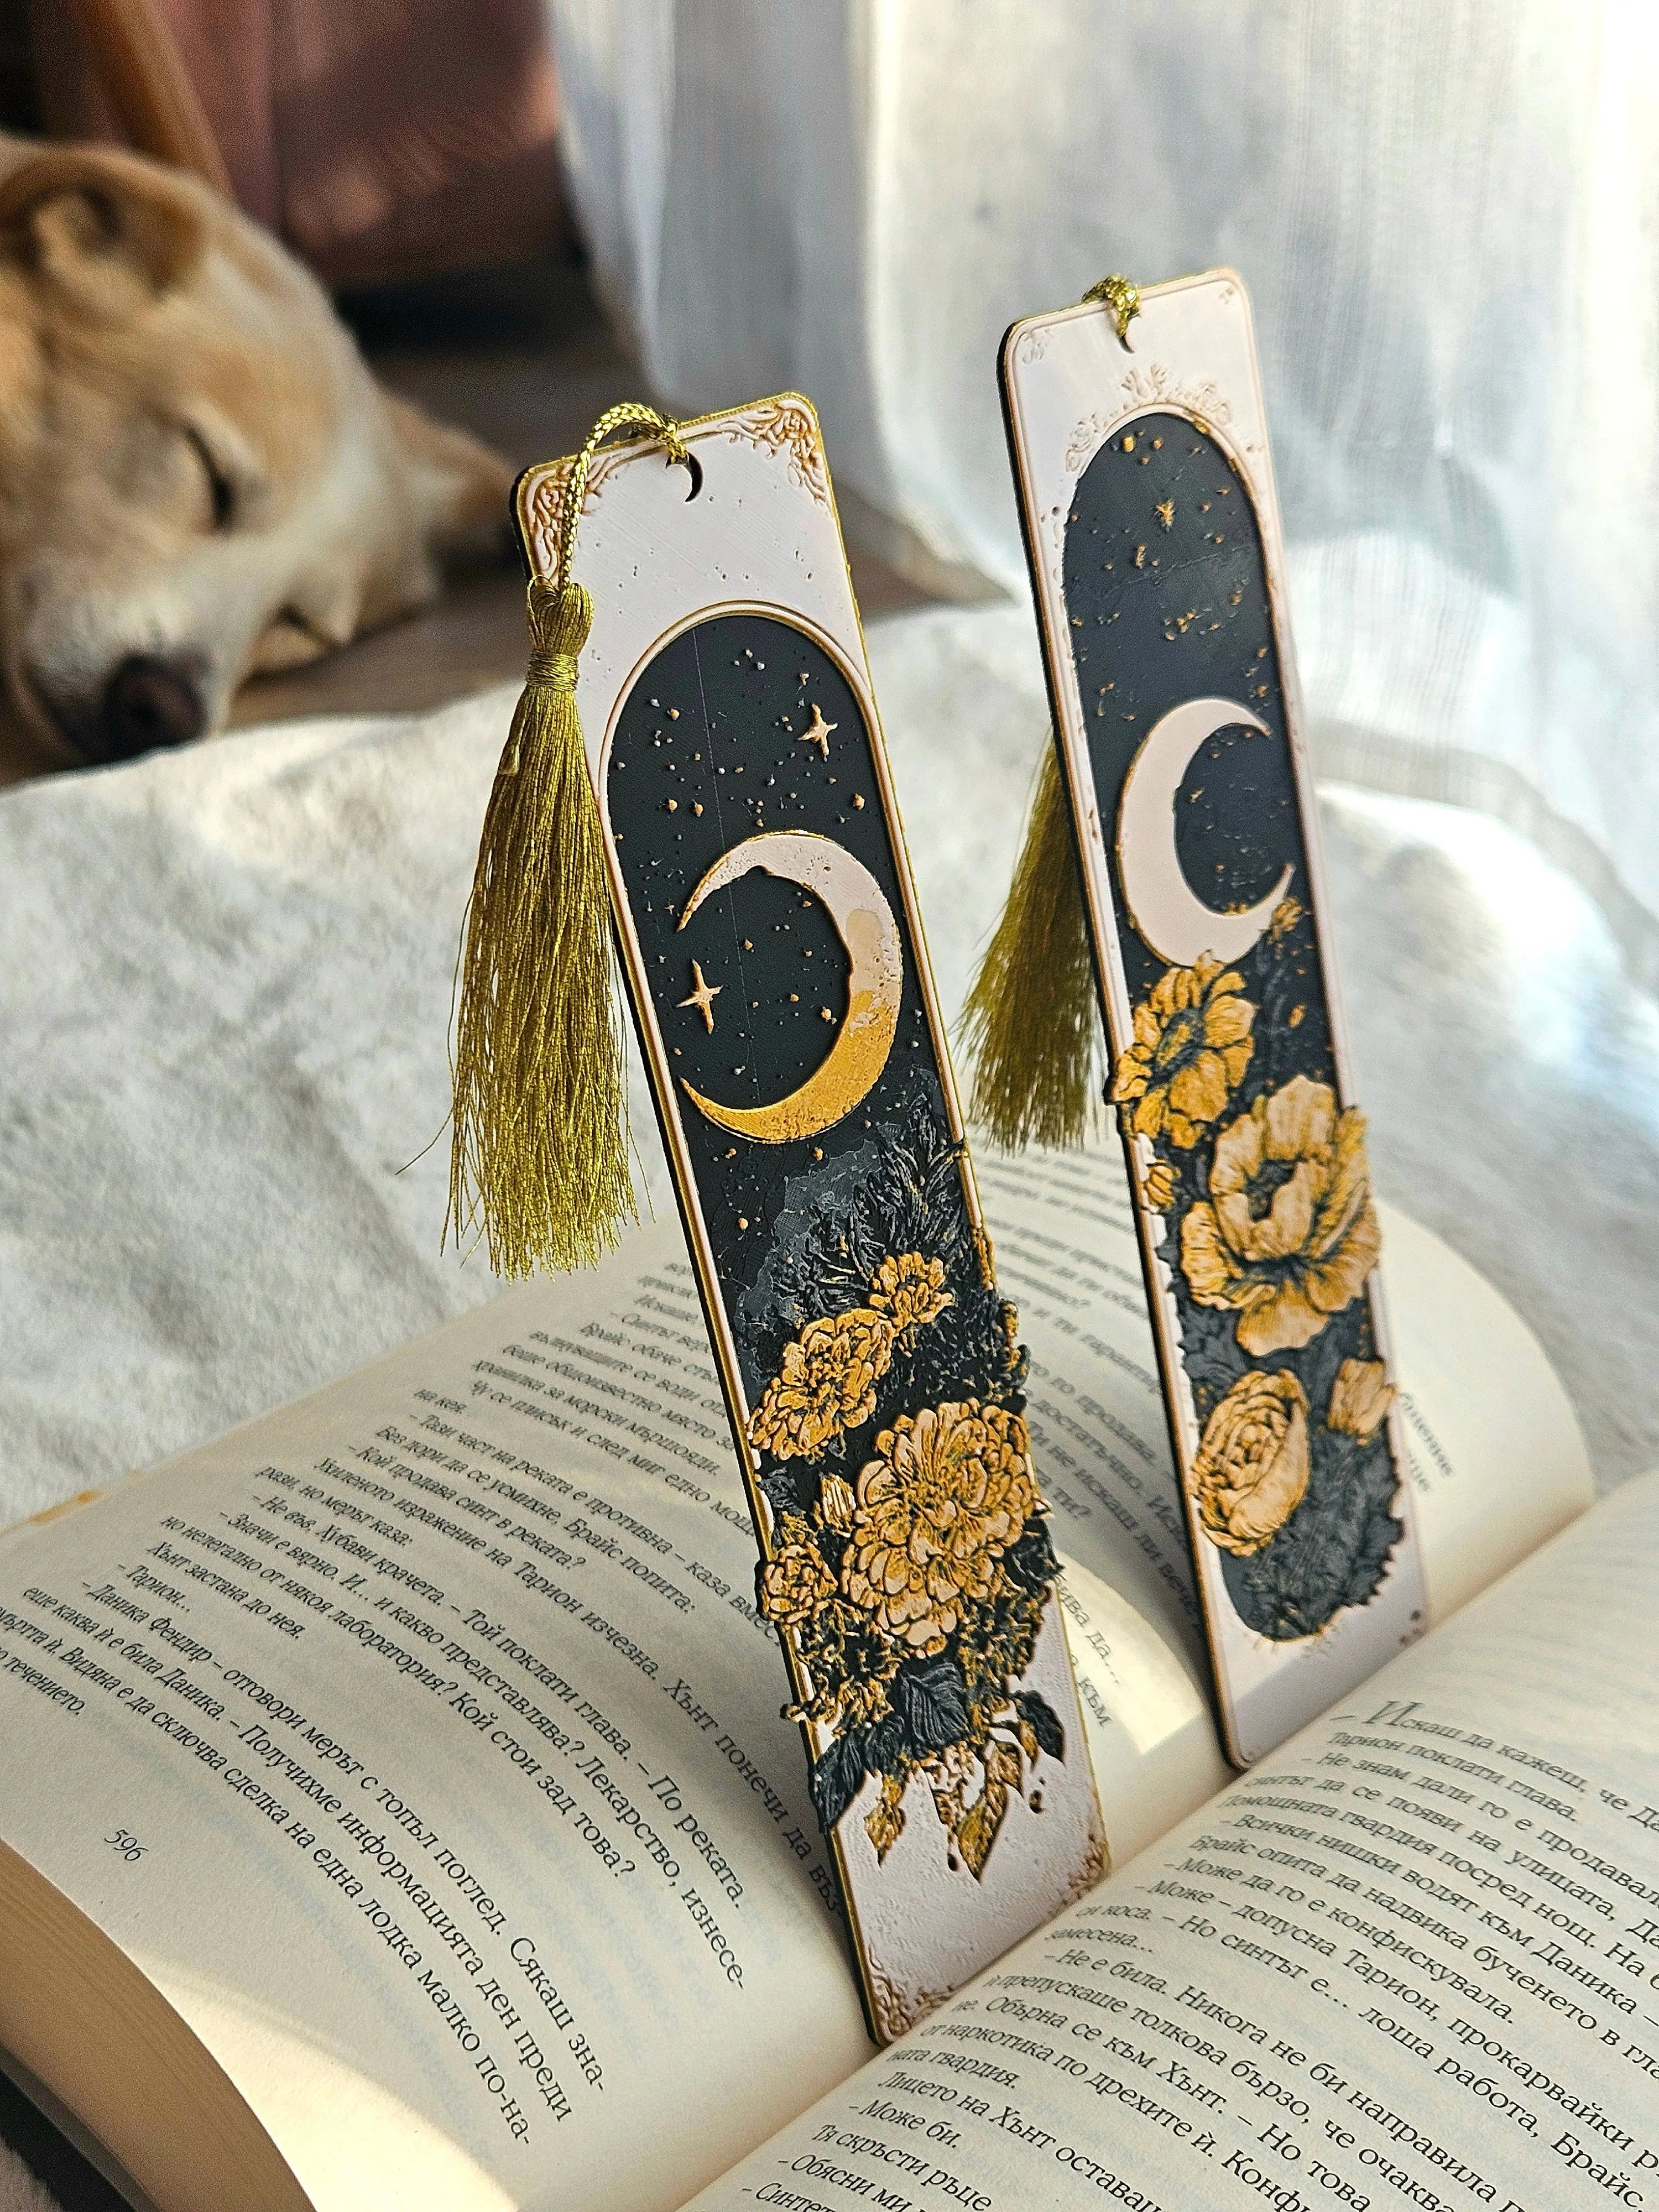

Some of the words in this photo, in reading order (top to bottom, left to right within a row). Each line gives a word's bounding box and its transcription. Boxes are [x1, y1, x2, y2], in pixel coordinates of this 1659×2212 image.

[563, 1395, 628, 1426] морски
[661, 1410, 716, 1438] място
[299, 1485, 325, 1499] но
[321, 1496, 374, 1524] мерът
[419, 1415, 458, 1438] Тази
[572, 1491, 588, 1500] е
[585, 1498, 672, 1554] противна
[685, 1562, 731, 1598] каза
[587, 1434, 630, 1459] след
[627, 1454, 666, 1474] миг
[665, 1474, 710, 1501] едно
[441, 1459, 468, 1474] да
[467, 1470, 491, 1483] се
[483, 1479, 561, 1525] усмихне,
[564, 1519, 623, 1558] Брайс
[456, 1497, 500, 1521] синт
[495, 1518, 512, 1528] в
[504, 1526, 586, 1569] реката?
[147, 1541, 191, 1568] Хънт
[185, 1564, 249, 1603] застана
[241, 1599, 272, 1614] до
[267, 1613, 305, 1639] нея.
[3, 1657, 85, 1715] течението.
[59, 1647, 121, 1691] Видяна
[117, 1688, 134, 1698] е
[485, 1548, 512, 1567] на
[514, 1562, 583, 1614] Тарион
[580, 1611, 659, 1681] изчезна.
[663, 1678, 718, 1731] Хънт
[714, 1734, 789, 1824] понечи
[1085, 1630, 1119, 1684] да...
[124, 1696, 155, 1715] да
[160, 1516, 186, 1530] но
[260, 1569, 285, 1583] от
[279, 1579, 334, 1613] някоя
[328, 1610, 458, 1695] лаборатория?
[449, 1692, 498, 1731] Кой
[491, 1731, 542, 1776] стои
[537, 1776, 577, 1815] зад
[574, 1812, 635, 1877] това?
[260, 1496, 288, 1514] Не
[463, 1609, 505, 1641] Той
[496, 1638, 579, 1703] поклати
[574, 1702, 630, 1761] глава.
[648, 1775, 682, 1811] По
[674, 1813, 743, 1908] реката.
[1078, 1676, 1113, 1729] към
[152, 1712, 227, 1770] сключва
[275, 1541, 290, 1550] е
[373, 1597, 394, 1610] и
[388, 1606, 444, 1644] какво
[440, 1642, 585, 1752] представлява?
[575, 1756, 680, 1886] Лекарство,
[681, 1888, 743, 1989] изнесе-
[1361, 1701, 1464, 1739] Искаш
[1460, 1734, 1494, 1749] да
[1600, 1790, 1629, 1810] че
[224, 1768, 289, 1824] сделка
[1316, 1752, 1351, 1766] Не
[1352, 1760, 1411, 1780] знам
[1411, 1776, 1476, 1804] дали
[1478, 1801, 1509, 1818] го
[1515, 1819, 1532, 1830] е
[1405, 1745, 1506, 1784] поклати
[1505, 1781, 1576, 1822] глава.
[52, 1604, 100, 1634] каква
[108, 1638, 124, 1648] е
[121, 1644, 164, 1674] била
[154, 1670, 225, 1721] Даника.
[238, 1724, 341, 1813] Получихме
[337, 1812, 483, 1976] информацията
[476, 1978, 521, 2030] ден
[514, 2031, 572, 2121] преди
[86, 1585, 149, 1624] Даника
[149, 1618, 212, 1662] Фендир
[223, 1670, 307, 1730] отговори
[301, 1726, 364, 1775] мерът
[361, 1777, 378, 1790] с
[377, 1788, 439, 1849] топъл
[434, 1849, 506, 1935] поглед.
[510, 1938, 574, 2031] Сякаш
[568, 2034, 603, 2090] зна-
[104, 1829, 149, 1861] 596
[285, 1822, 315, 1849] на
[314, 1849, 363, 1898] една
[1313, 1780, 1347, 1791] да
[1352, 1787, 1381, 1800] се
[1386, 1797, 1464, 1832] появи
[1467, 1830, 1501, 1852] на
[1504, 1850, 1614, 1921] улицата,
[1233, 1814, 1317, 1840] Всички
[1315, 1835, 1402, 1875] нишки
[1401, 1870, 1479, 1912] водят
[1478, 1911, 1535, 1947] към
[1530, 1942, 1650, 2020] Даника
[1338, 1812, 1438, 1855] гвардия
[1437, 1851, 1533, 1908] посред
[1532, 1903, 1596, 1948] нощ.
[1604, 1942, 1645, 1977] На
[358, 1899, 421, 1969] лодка
[1176, 1858, 1243, 1881] Може
[1240, 1875, 1275, 1891] да
[1275, 1886, 1305, 1902] го
[1308, 1900, 1327, 1911] е
[1327, 1908, 1512, 2023] конфискувала.
[1188, 1835, 1258, 1854] Брайс
[1257, 1849, 1328, 1878] опита
[1325, 1873, 1361, 1893] да
[1363, 1888, 1469, 1950] надвика
[1474, 1946, 1597, 2029] бученето
[1599, 2029, 1620, 2046] в
[418, 1969, 479, 2051] малко
[1147, 1880, 1215, 1903] Може
[1232, 1905, 1337, 1957] допусна
[1343, 1949, 1439, 2021] Тарион,
[1448, 2018, 1634, 2151] прокарвайки
[1178, 1915, 1217, 1937] Но
[1221, 1935, 1308, 1979] синтът
[1311, 1979, 1347, 2007] е...
[1358, 2008, 1434, 2059] лоша
[1434, 2058, 1538, 2137] работа,
[929, 2052, 1020, 2089] гвардия.
[942, 2025, 1054, 2062] наркотика
[1052, 2055, 1088, 2076] по
[1084, 2072, 1192, 2137] дрехите
[986, 1997, 1068, 2028] Обърна
[1072, 2023, 1102, 2041] се
[1103, 2037, 1157, 2069] към
[1156, 2061, 1227, 2114] Хънт.
[1257, 2125, 1301, 2160] Но
[1308, 2161, 1370, 2212] това
[1056, 1949, 1091, 1966] Не
[1091, 1959, 1109, 1970] е
[1110, 1961, 1167, 1995] била.
[1174, 1985, 1267, 2044] Никога
[1269, 2041, 1306, 2066] не
[1310, 2063, 1348, 2094] би
[1347, 2091, 1496, 2203] направила
[1130, 2007, 1227, 2065] толкова
[1231, 2060, 1309, 2124] бързо,
[1325, 2120, 1355, 2148] че
[859, 2100, 925, 2130] Може
[926, 2121, 961, 2148] би.
[878, 2072, 958, 2101] Лицето
[957, 2095, 990, 2116] на
[989, 2107, 1056, 2148] Хънт
[791, 2155, 875, 2195] Обясни
[836, 2133, 930, 2176] скръсти
[921, 2170, 991, 2211] ръце
